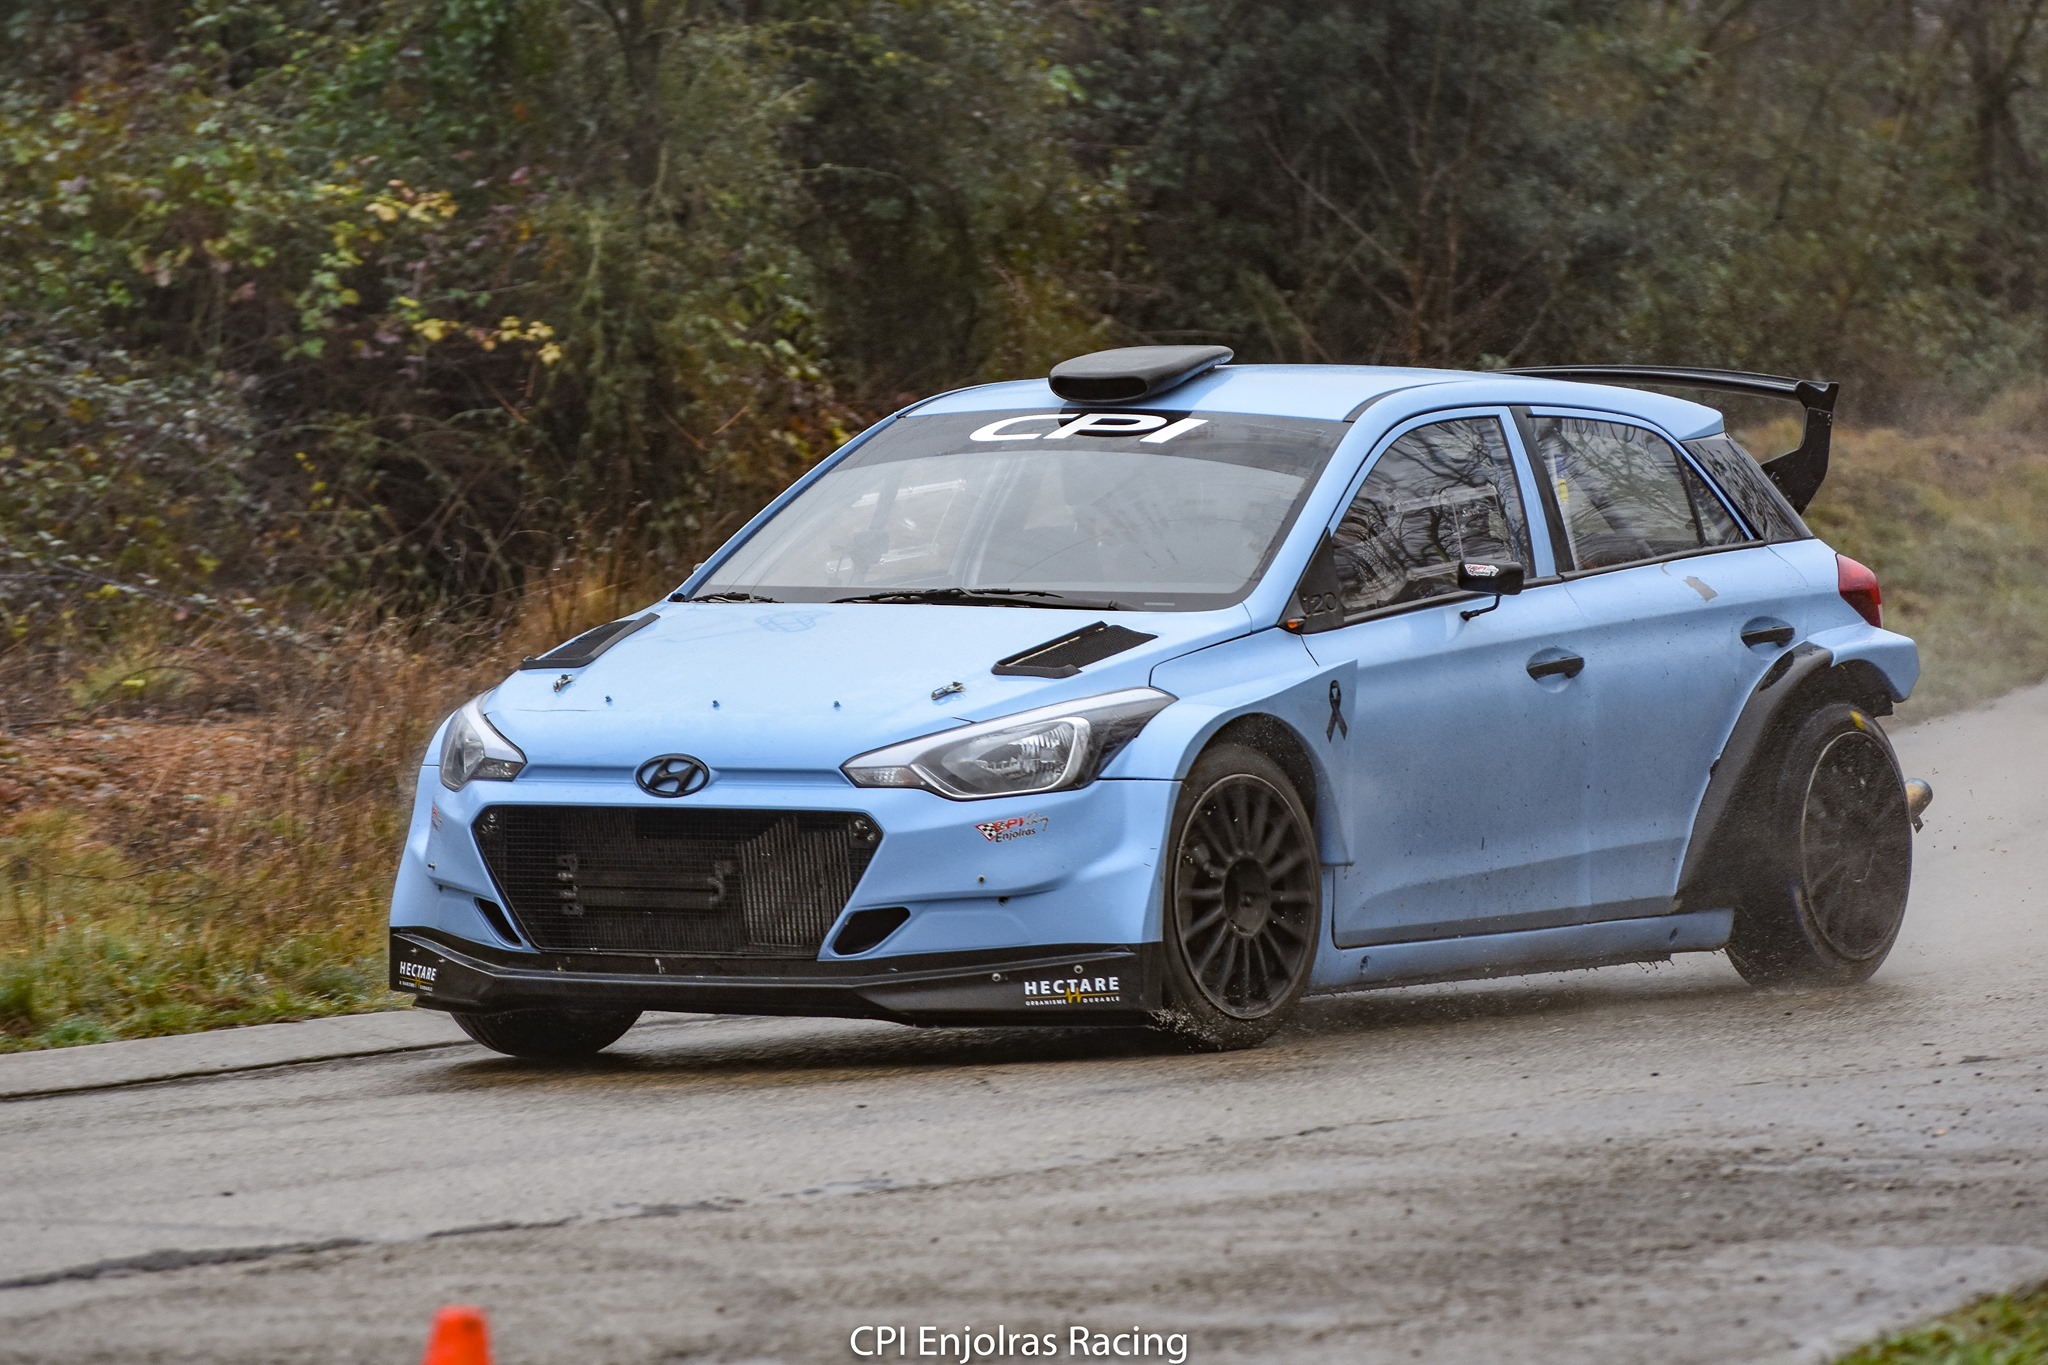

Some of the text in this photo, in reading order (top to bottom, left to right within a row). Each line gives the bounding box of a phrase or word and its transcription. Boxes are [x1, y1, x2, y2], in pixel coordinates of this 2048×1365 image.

[969, 413, 1209, 444] CPI
[995, 828, 1036, 842] Enjolras
[399, 960, 437, 981] HECTARE
[1024, 976, 1120, 995] HECTARE
[1082, 996, 1120, 1004] DURABLE
